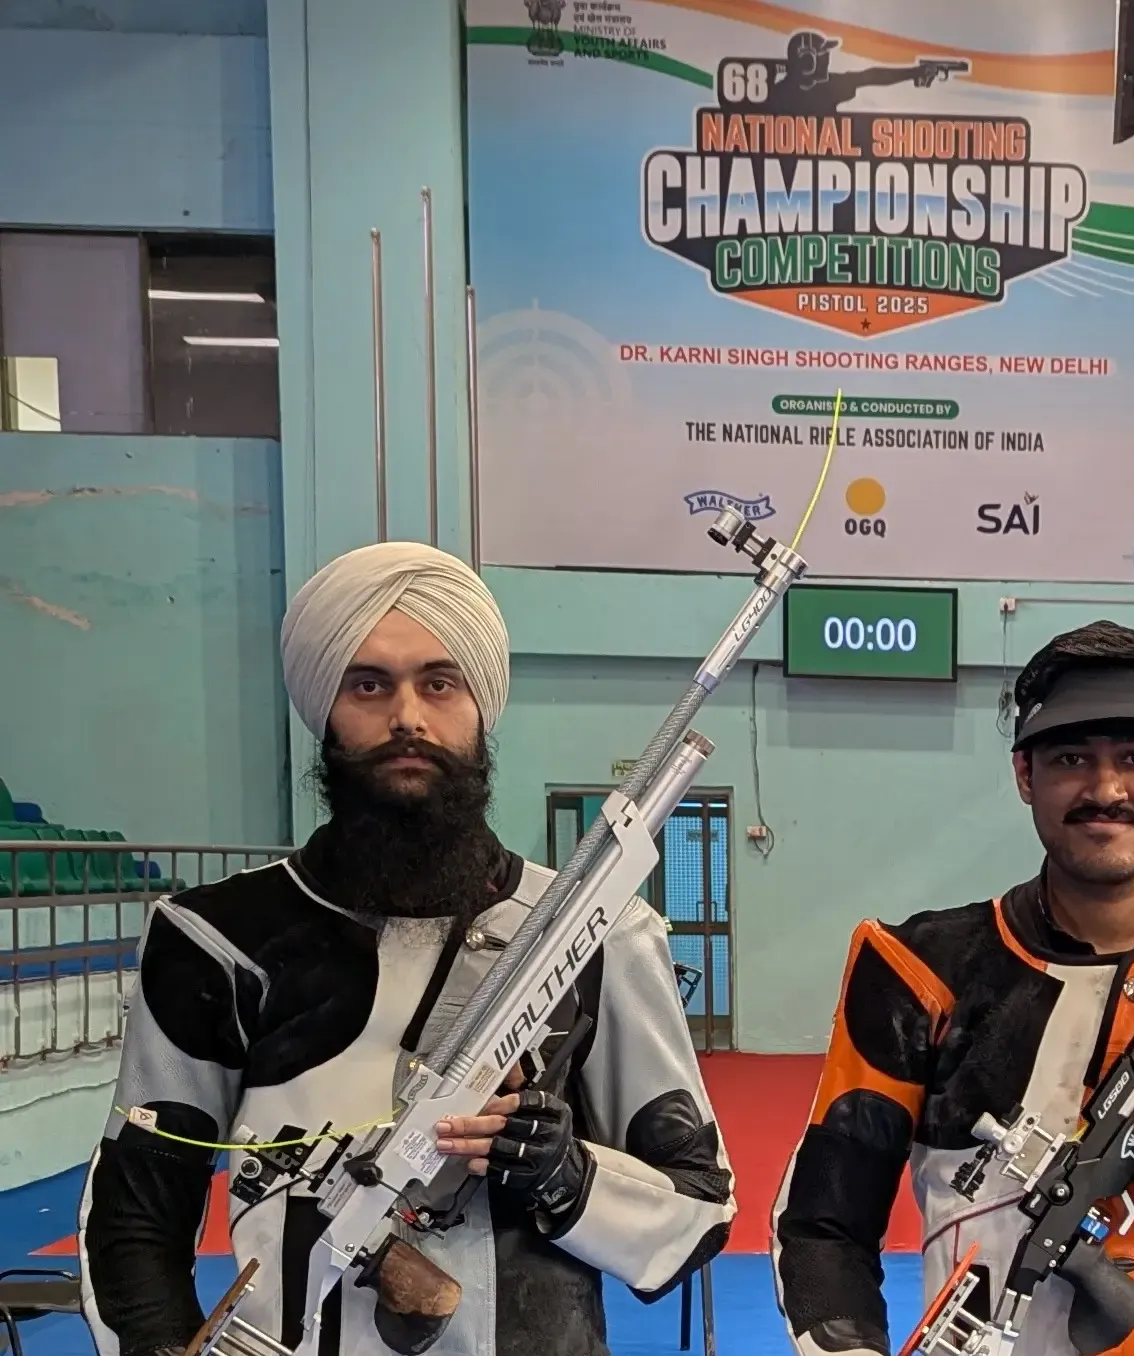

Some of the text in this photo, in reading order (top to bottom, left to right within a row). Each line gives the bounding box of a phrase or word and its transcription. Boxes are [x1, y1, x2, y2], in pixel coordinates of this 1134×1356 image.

[722, 62, 769, 103] 68
[701, 112, 1027, 161] NATIONAL SHOOTING
[645, 155, 1083, 252] CHAMPIONSHIP
[714, 236, 1001, 293] COMPETITIONS
[797, 292, 930, 315] PISTOL 2025
[620, 344, 1108, 375] DR. KARNI SINGH SHOOTING RANGES, NEW DELHI
[850, 401, 859, 413] &
[861, 402, 934, 415] CONDUCTED
[936, 404, 951, 415] BY
[685, 421, 1044, 452] THE NATIONAL RIFLE ASSOCIATION OF INDIA
[844, 518, 887, 538] OGQ
[734, 590, 773, 642] LG400
[823, 616, 917, 652] 00:00
[494, 906, 609, 1069] WALTHER
[1098, 1071, 1130, 1120] LG500
